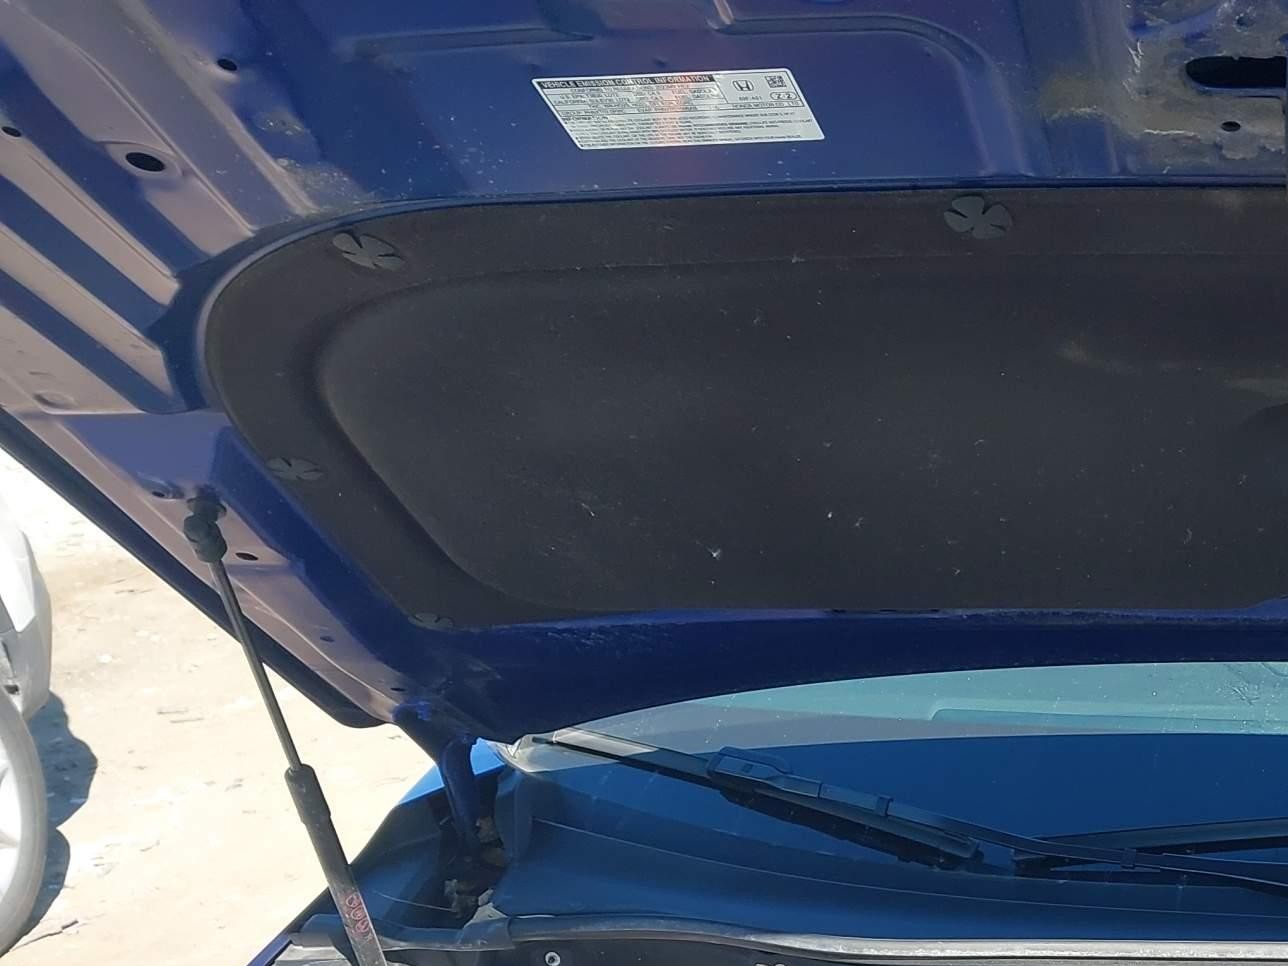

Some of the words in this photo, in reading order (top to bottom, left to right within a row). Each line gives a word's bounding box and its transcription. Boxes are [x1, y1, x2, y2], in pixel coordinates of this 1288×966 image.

[541, 81, 576, 89] VEHICLE
[576, 79, 615, 87] EMISSION
[616, 77, 653, 85] CONTROL
[655, 75, 710, 84] INFORMATION
